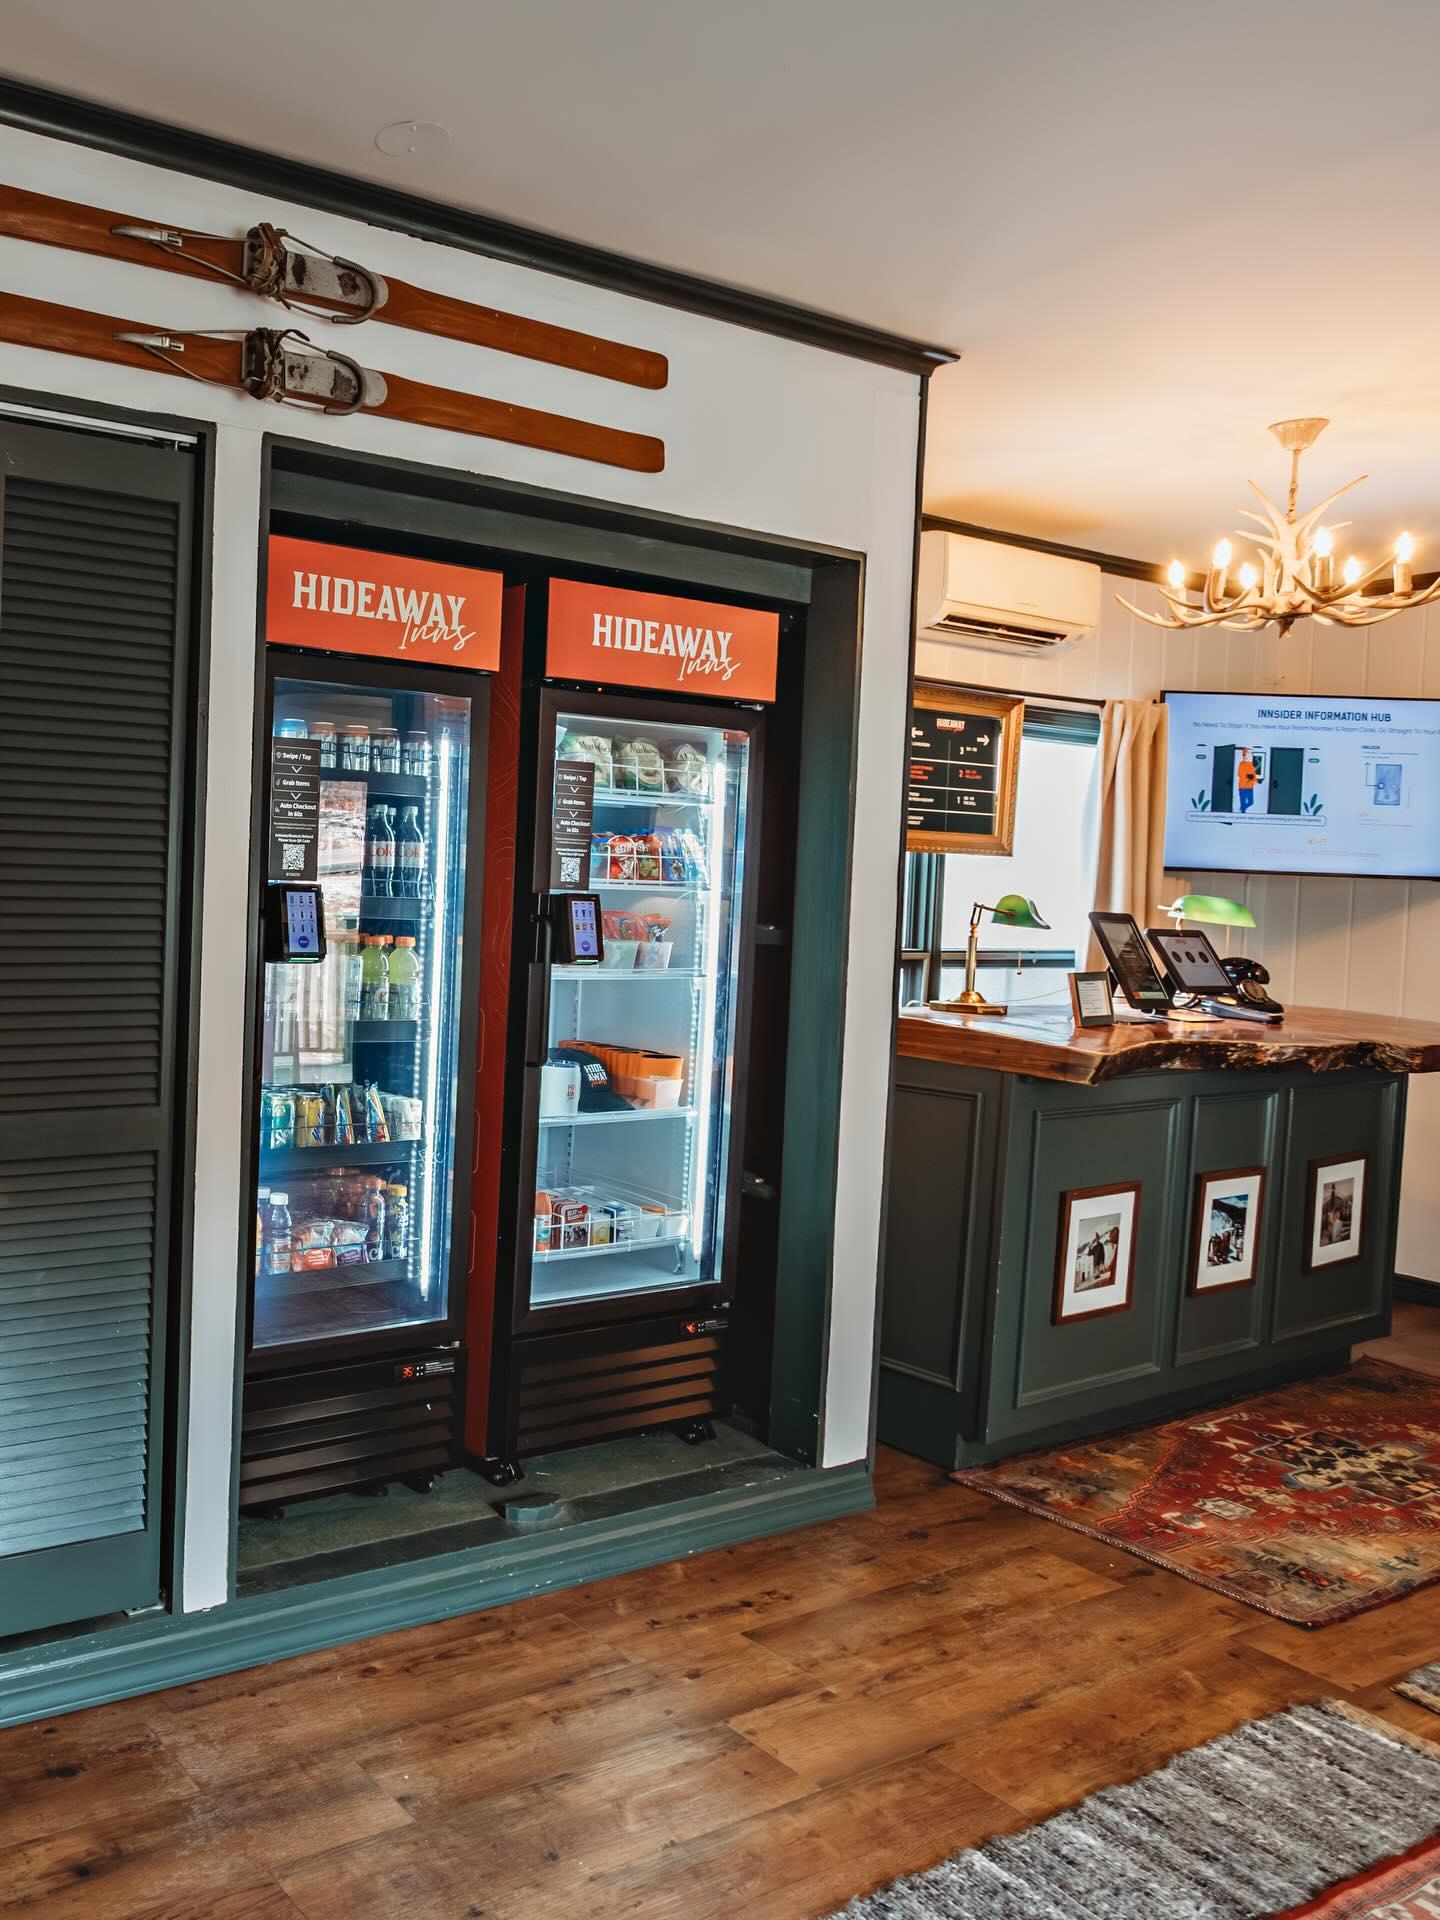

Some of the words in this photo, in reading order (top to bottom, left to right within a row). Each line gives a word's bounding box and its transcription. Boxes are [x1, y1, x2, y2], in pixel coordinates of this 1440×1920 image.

[292, 571, 466, 630] HIDEAWAY
[398, 612, 476, 650] Inns
[592, 613, 733, 662] HIDEAWAY
[677, 646, 740, 681] Inns
[1257, 709, 1302, 719] INNSIDER
[1304, 711, 1367, 721] INFORMATION
[1371, 713, 1391, 721] HUB
[282, 752, 298, 760] Swipe
[583, 1063, 604, 1074] HIDE
